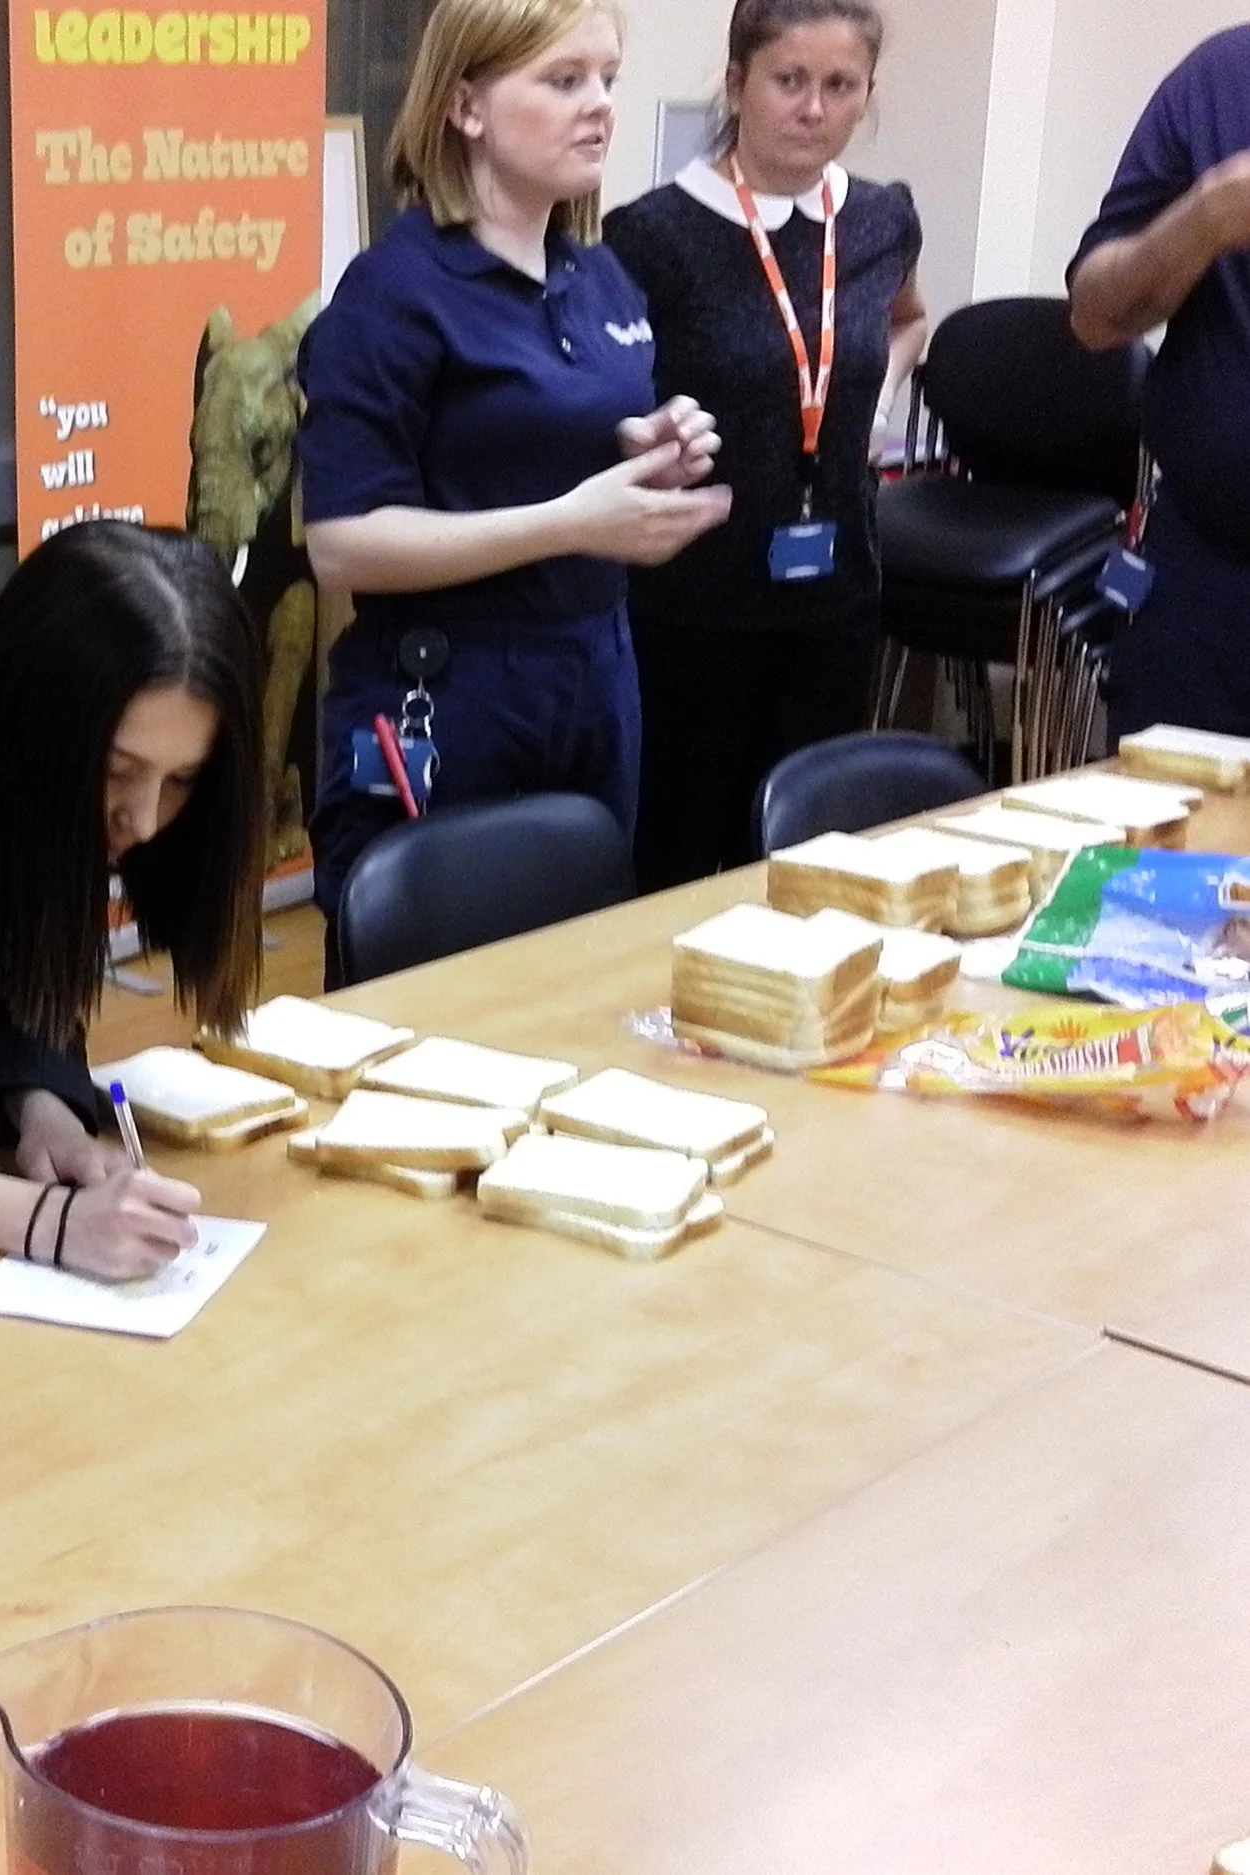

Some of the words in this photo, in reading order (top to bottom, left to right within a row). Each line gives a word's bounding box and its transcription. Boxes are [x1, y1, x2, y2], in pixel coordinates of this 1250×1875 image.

[35, 126, 132, 185] The
[142, 127, 309, 181] Nature
[64, 211, 116, 269] of
[126, 206, 286, 273] Safety
[40, 449, 94, 490] will
